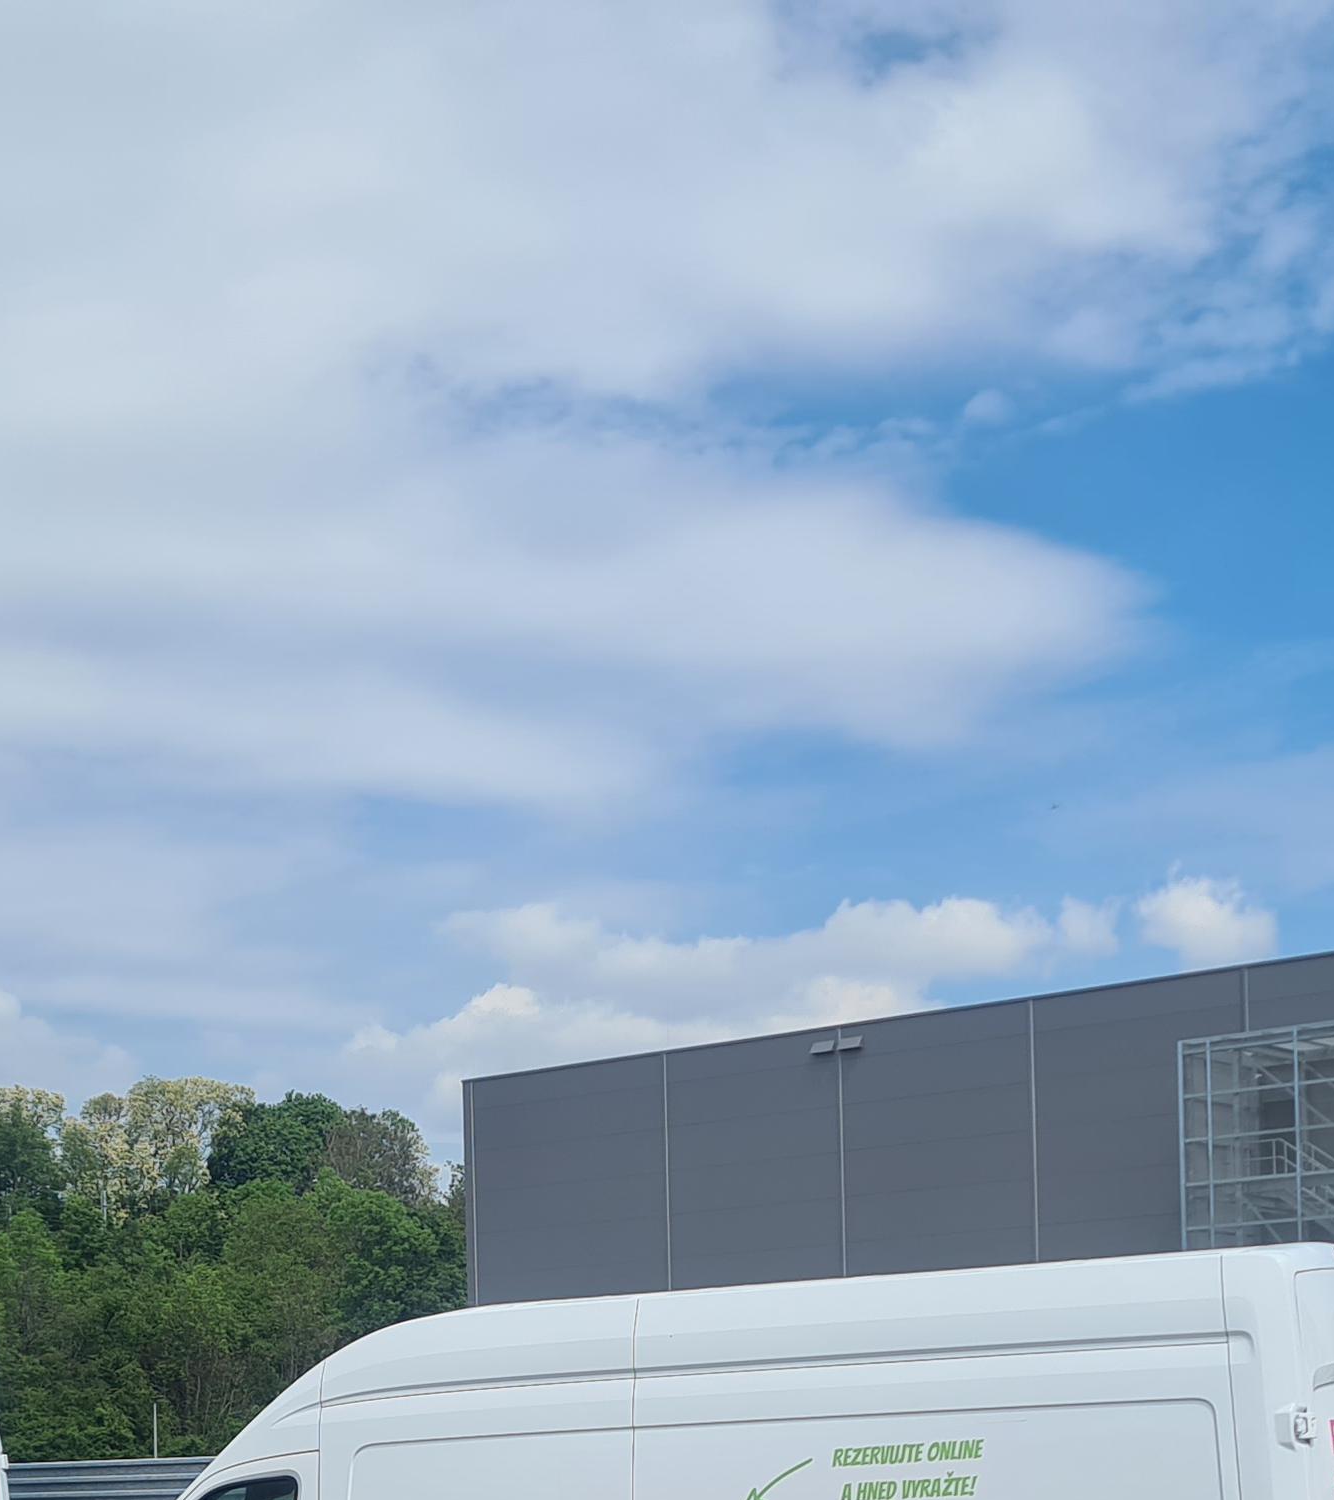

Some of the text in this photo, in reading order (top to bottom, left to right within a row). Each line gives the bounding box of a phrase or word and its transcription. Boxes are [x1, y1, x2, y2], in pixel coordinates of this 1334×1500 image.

[832, 1438, 985, 1468] REZERVUJTE ONLINE
[901, 1470, 979, 1499] VYRAŽTE!
